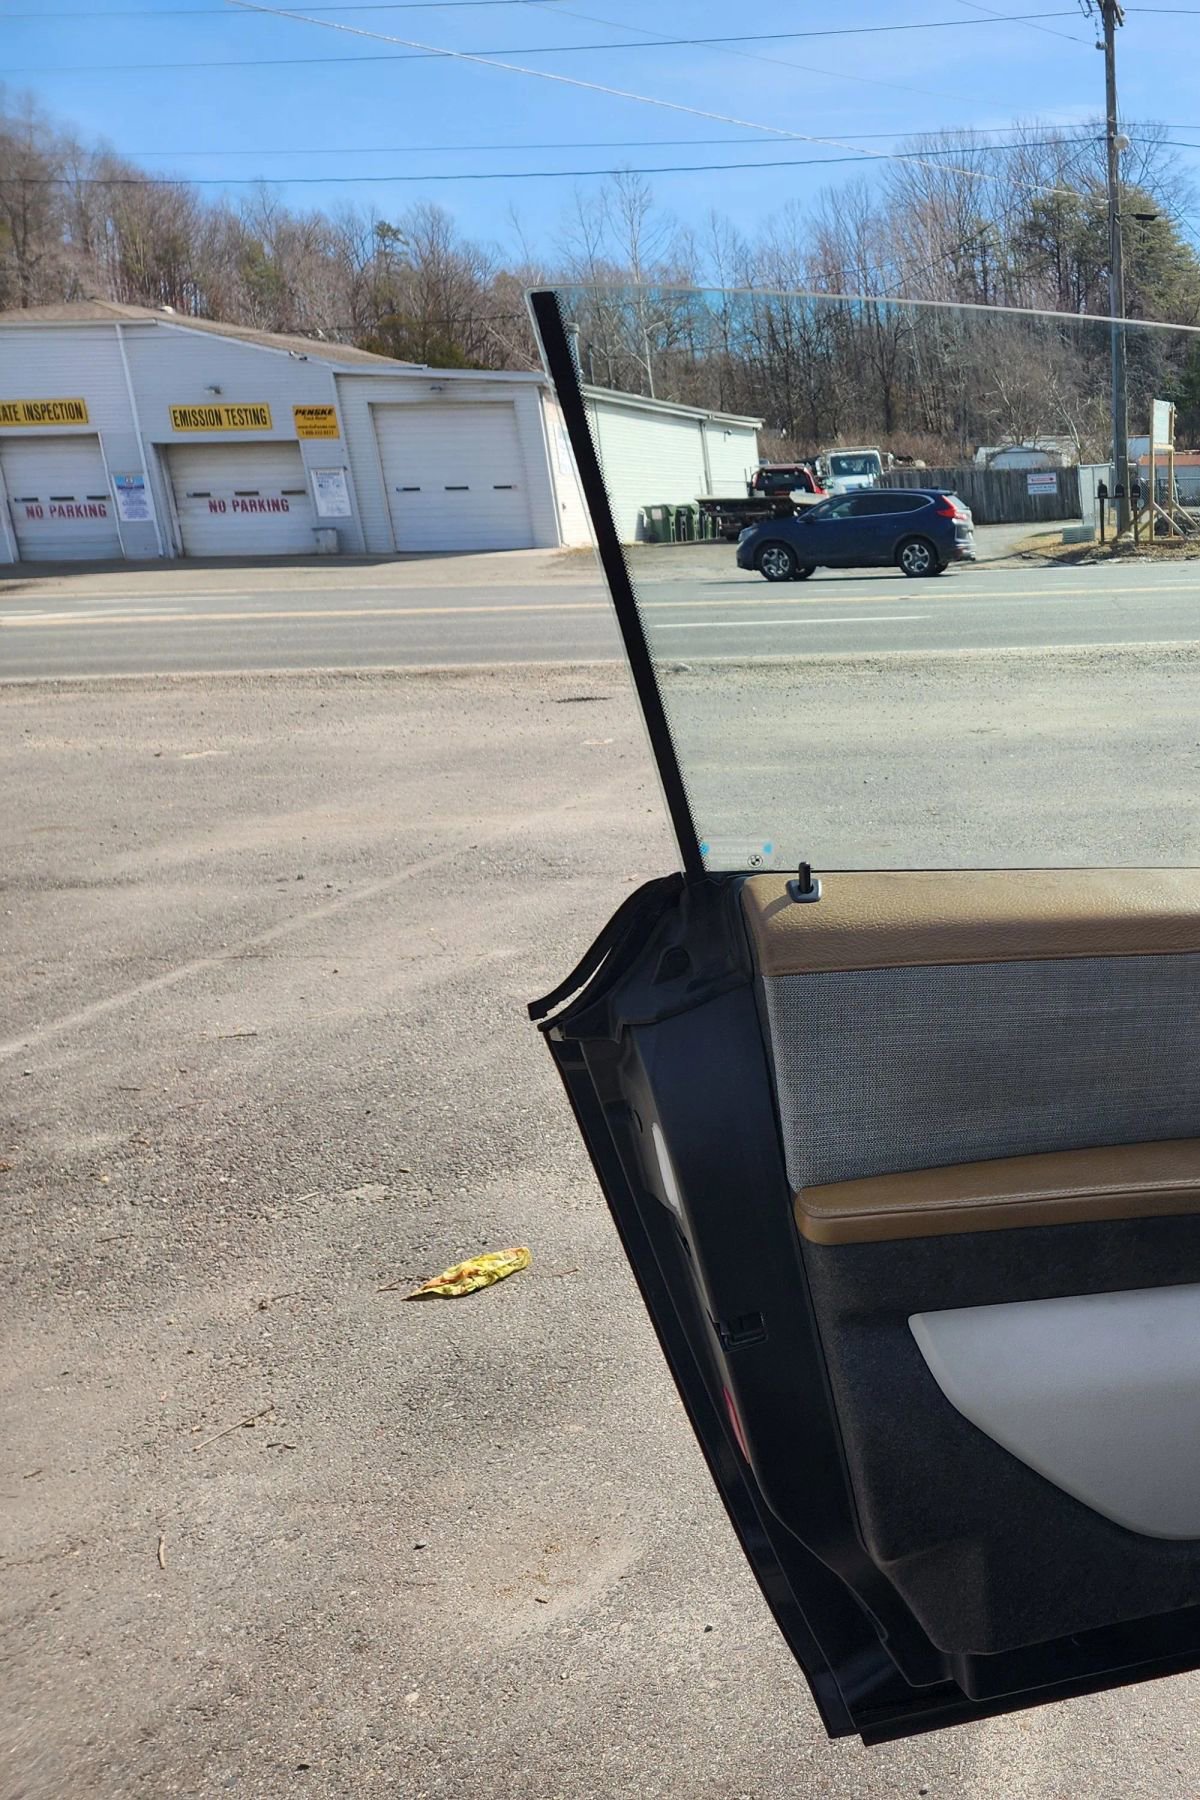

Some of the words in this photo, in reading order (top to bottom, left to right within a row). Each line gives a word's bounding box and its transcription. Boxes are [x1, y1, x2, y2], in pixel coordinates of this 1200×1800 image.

[0, 403, 21, 422] ATE
[22, 401, 84, 421] INSPECTION
[172, 408, 223, 428] EMISSION
[224, 407, 268, 426] TESTING
[294, 408, 335, 416] PENSKE
[25, 504, 44, 519] NO
[48, 503, 107, 518] PARKING
[208, 499, 226, 513] NO
[232, 498, 290, 513] PARKING
